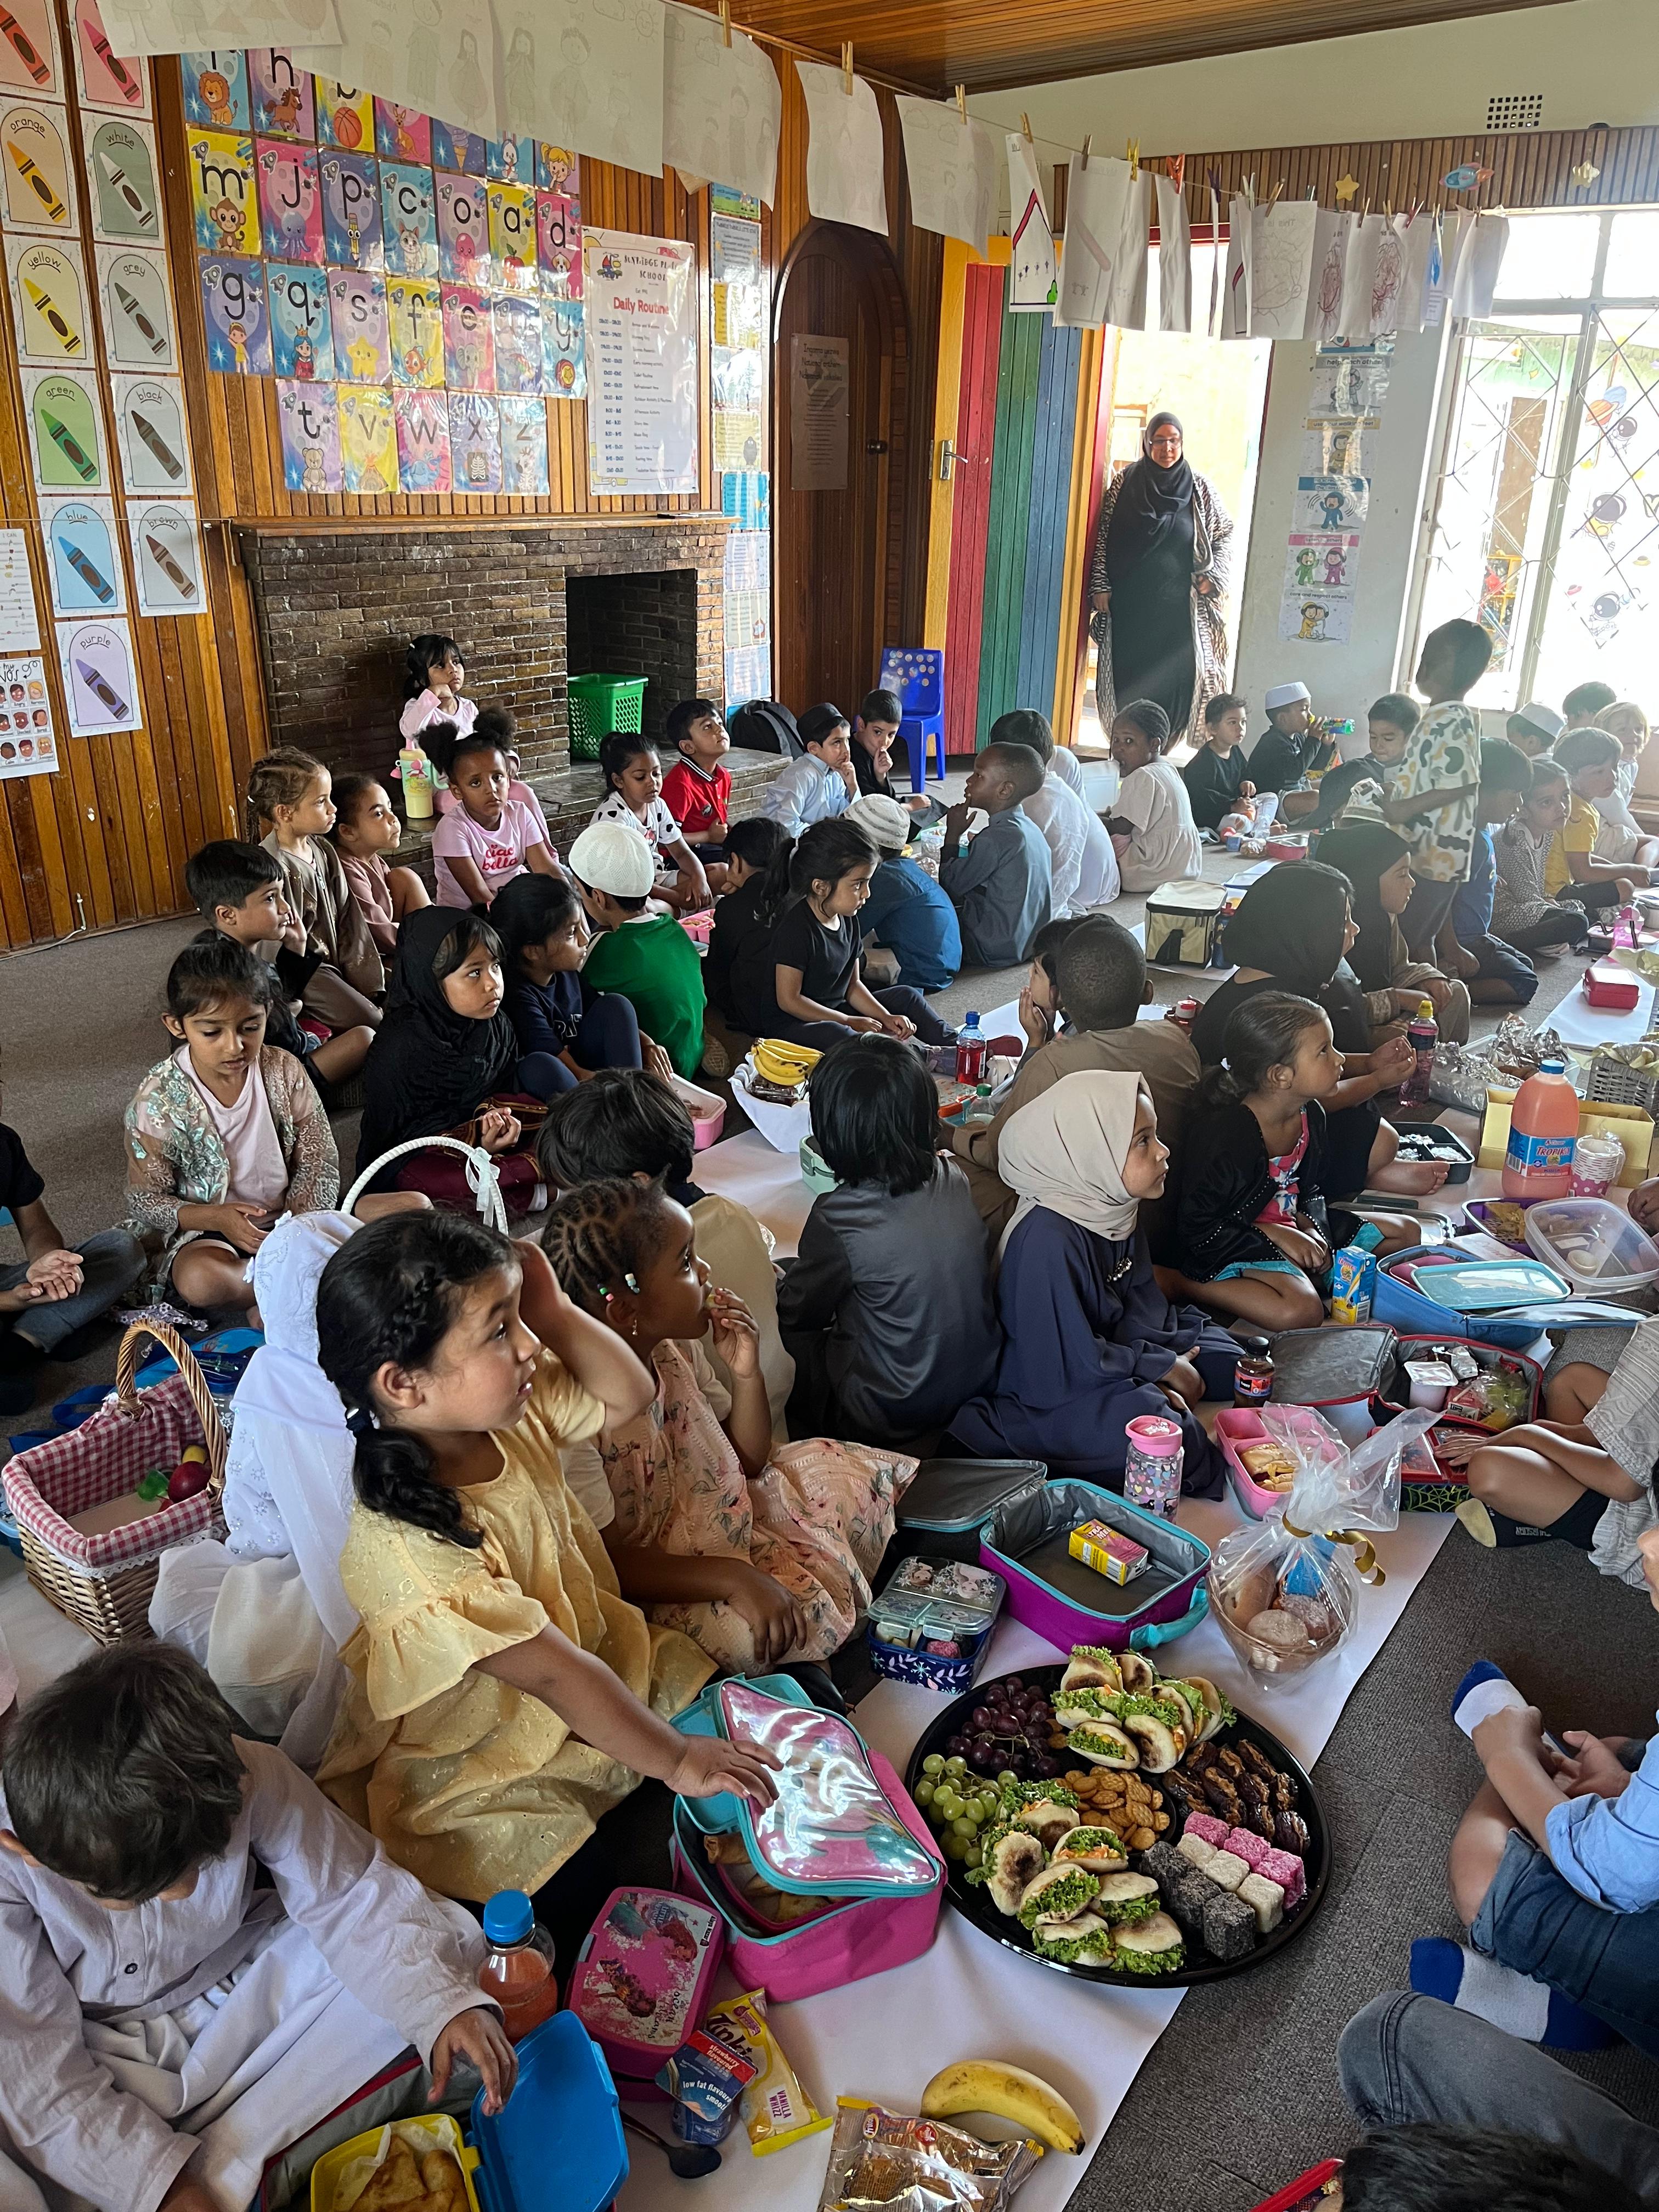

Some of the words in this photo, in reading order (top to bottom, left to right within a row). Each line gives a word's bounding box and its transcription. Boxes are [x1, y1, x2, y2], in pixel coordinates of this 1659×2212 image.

[10, 119, 46, 134] orange
[106, 132, 134, 146] white
[200, 161, 245, 200] m
[281, 159, 302, 208] j
[341, 175, 362, 219] p
[398, 187, 417, 215] c
[454, 197, 471, 223] o
[504, 206, 521, 233] a
[551, 205, 567, 249] d
[27, 254, 61, 269] yellow
[123, 263, 146, 277] grey
[221, 272, 246, 320] g
[287, 280, 314, 326] q
[351, 294, 368, 321] s
[614, 297, 635, 315] Daily
[638, 300, 669, 315] Routine
[408, 294, 425, 340] f
[460, 304, 478, 330] e
[554, 313, 572, 352] y
[46, 386, 75, 400] green
[136, 390, 162, 403] black
[297, 400, 321, 439] t
[358, 415, 379, 442] v
[409, 418, 438, 445] w
[467, 415, 484, 442] x
[66, 510, 88, 522] blue
[146, 517, 178, 529] brown
[80, 634, 111, 651] purple
[3, 663, 14, 672] my
[486, 844, 514, 858] ciao
[482, 857, 518, 871] bella
[1537, 1146, 1571, 1156] TROPIKA
[707, 2050, 734, 2070] flavoured
[709, 2045, 740, 2067] strawberry
[697, 2080, 707, 2089] fat
[769, 2095, 782, 2118] WHIZZ
[777, 2090, 792, 2118] VANILLA
